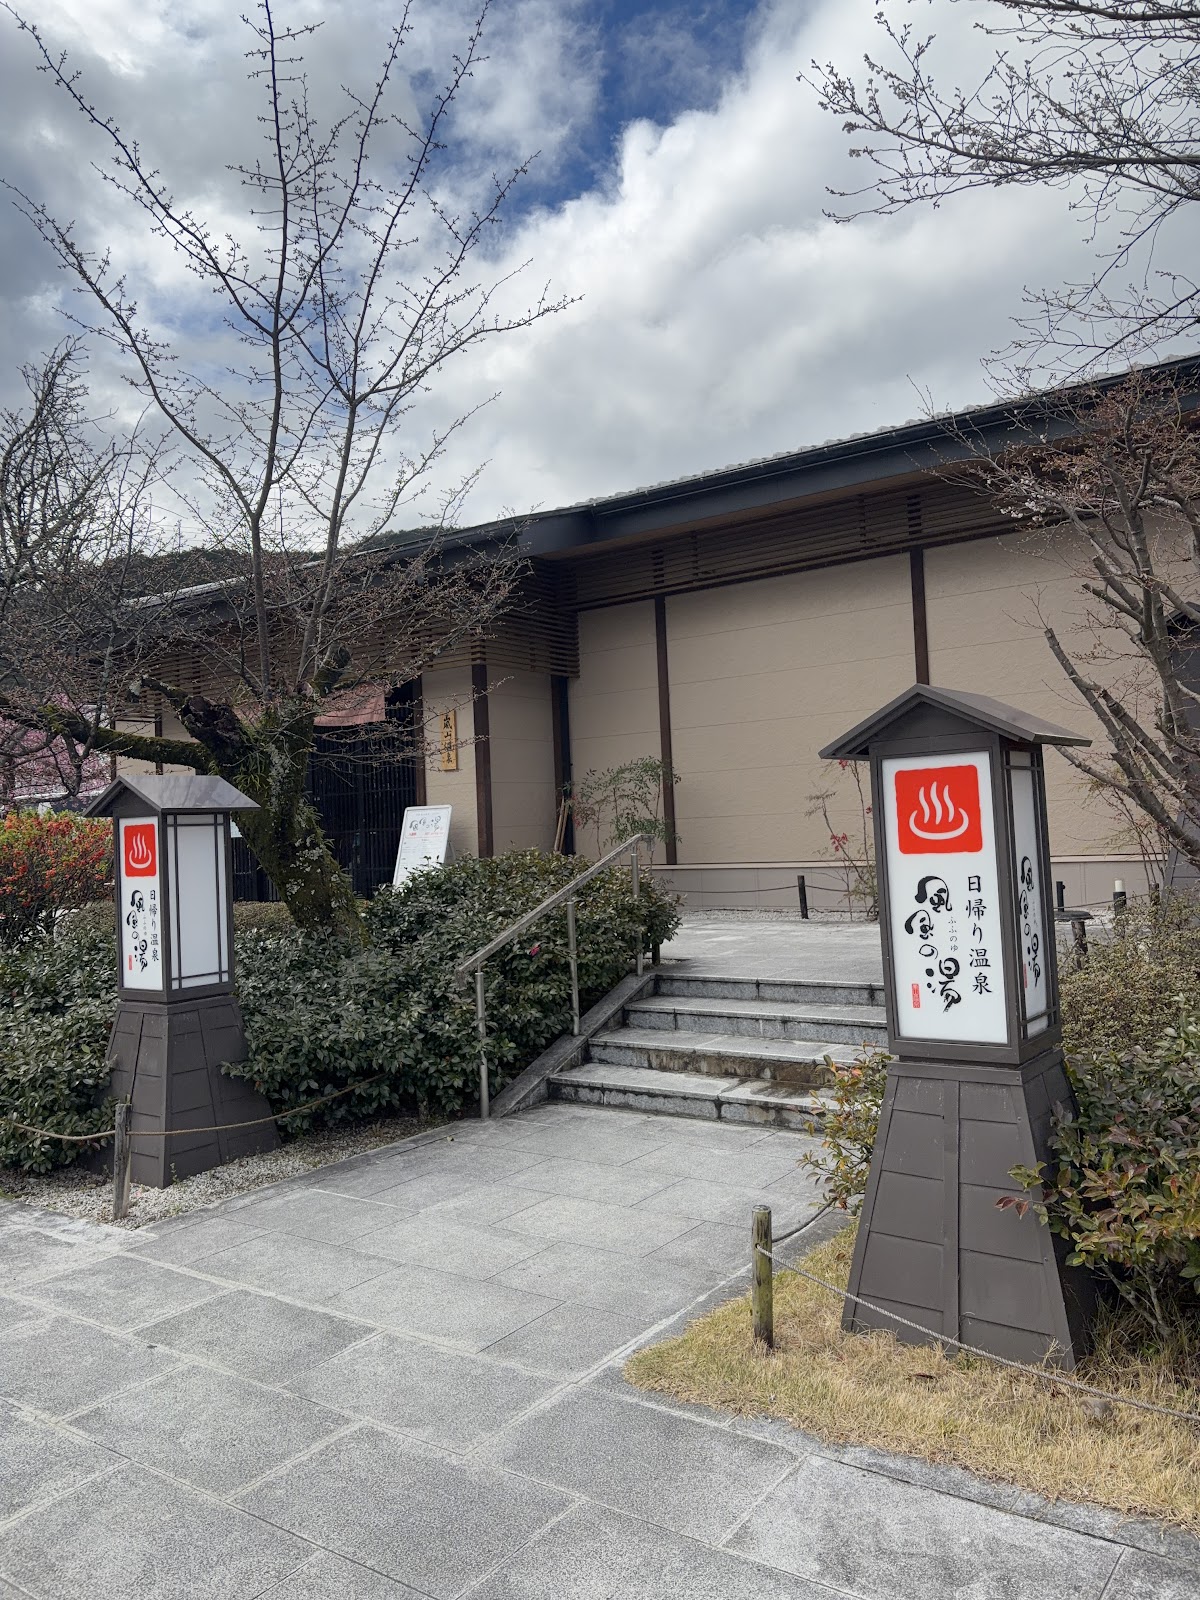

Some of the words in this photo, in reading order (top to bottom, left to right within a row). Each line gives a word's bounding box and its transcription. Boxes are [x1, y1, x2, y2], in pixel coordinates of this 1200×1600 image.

[126, 889, 148, 973] 風風の湯
[149, 889, 159, 962] 日帰り温泉
[904, 875, 962, 1013] 風風の湯
[947, 916, 959, 952] ふふのゆ
[965, 875, 992, 994] 日帰り温泉
